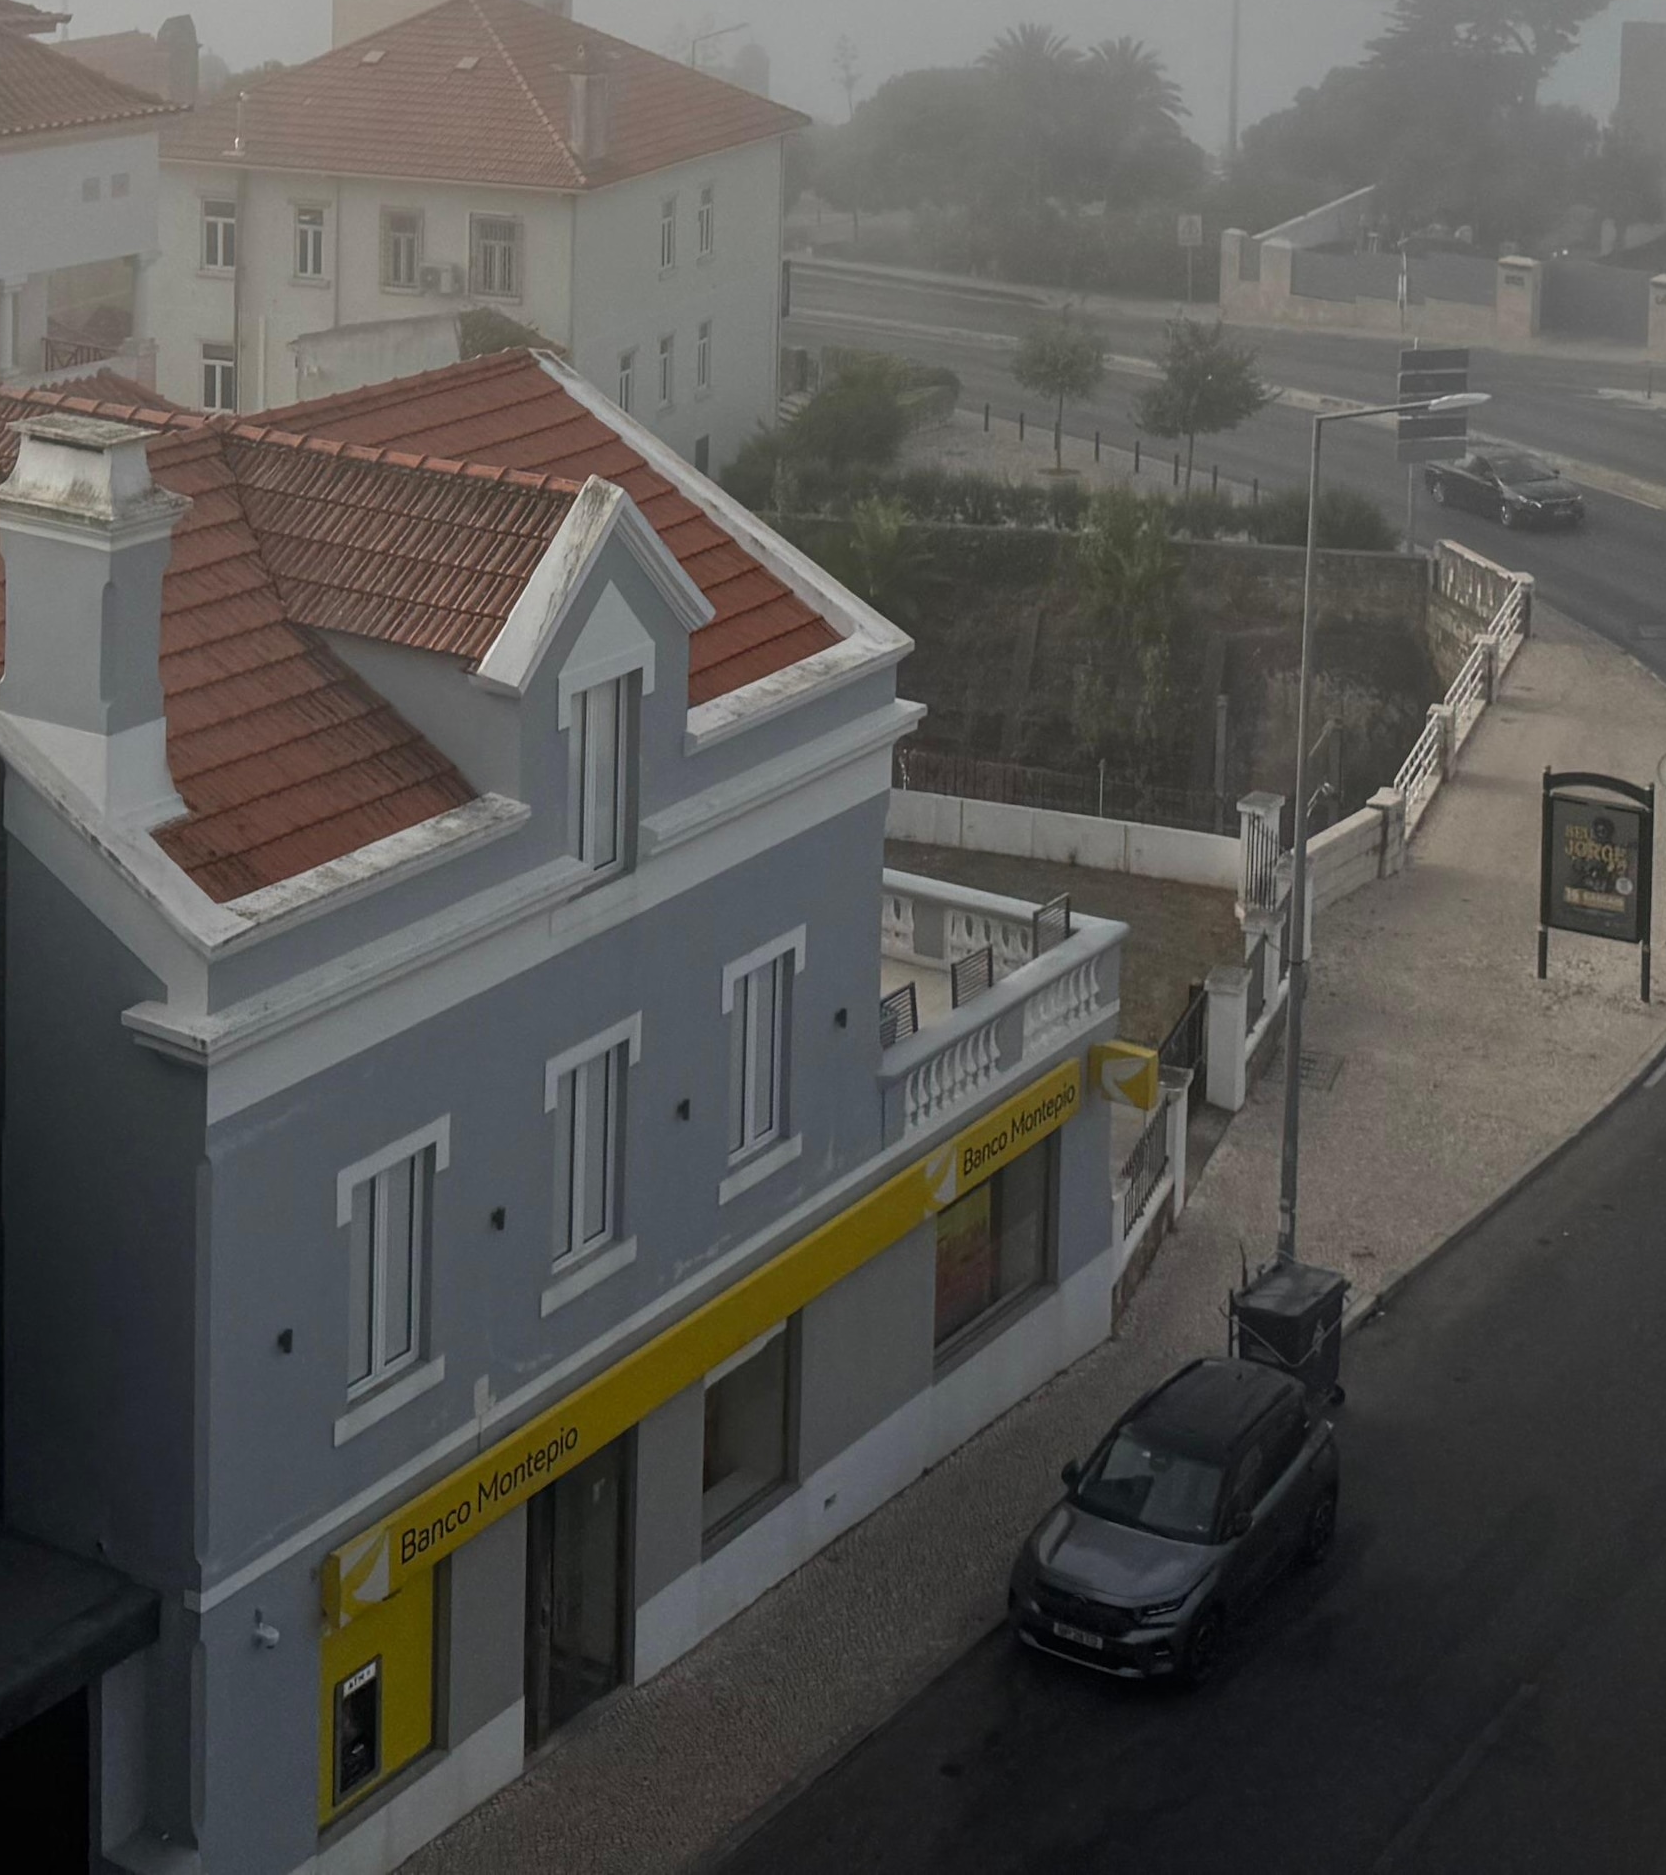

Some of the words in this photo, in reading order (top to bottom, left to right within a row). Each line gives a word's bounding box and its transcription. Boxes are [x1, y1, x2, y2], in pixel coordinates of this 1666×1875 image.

[963, 1130, 1007, 1176] Banco
[1011, 1083, 1075, 1143] Montepio
[400, 1501, 471, 1565] Banco
[477, 1426, 579, 1513] Montepio
